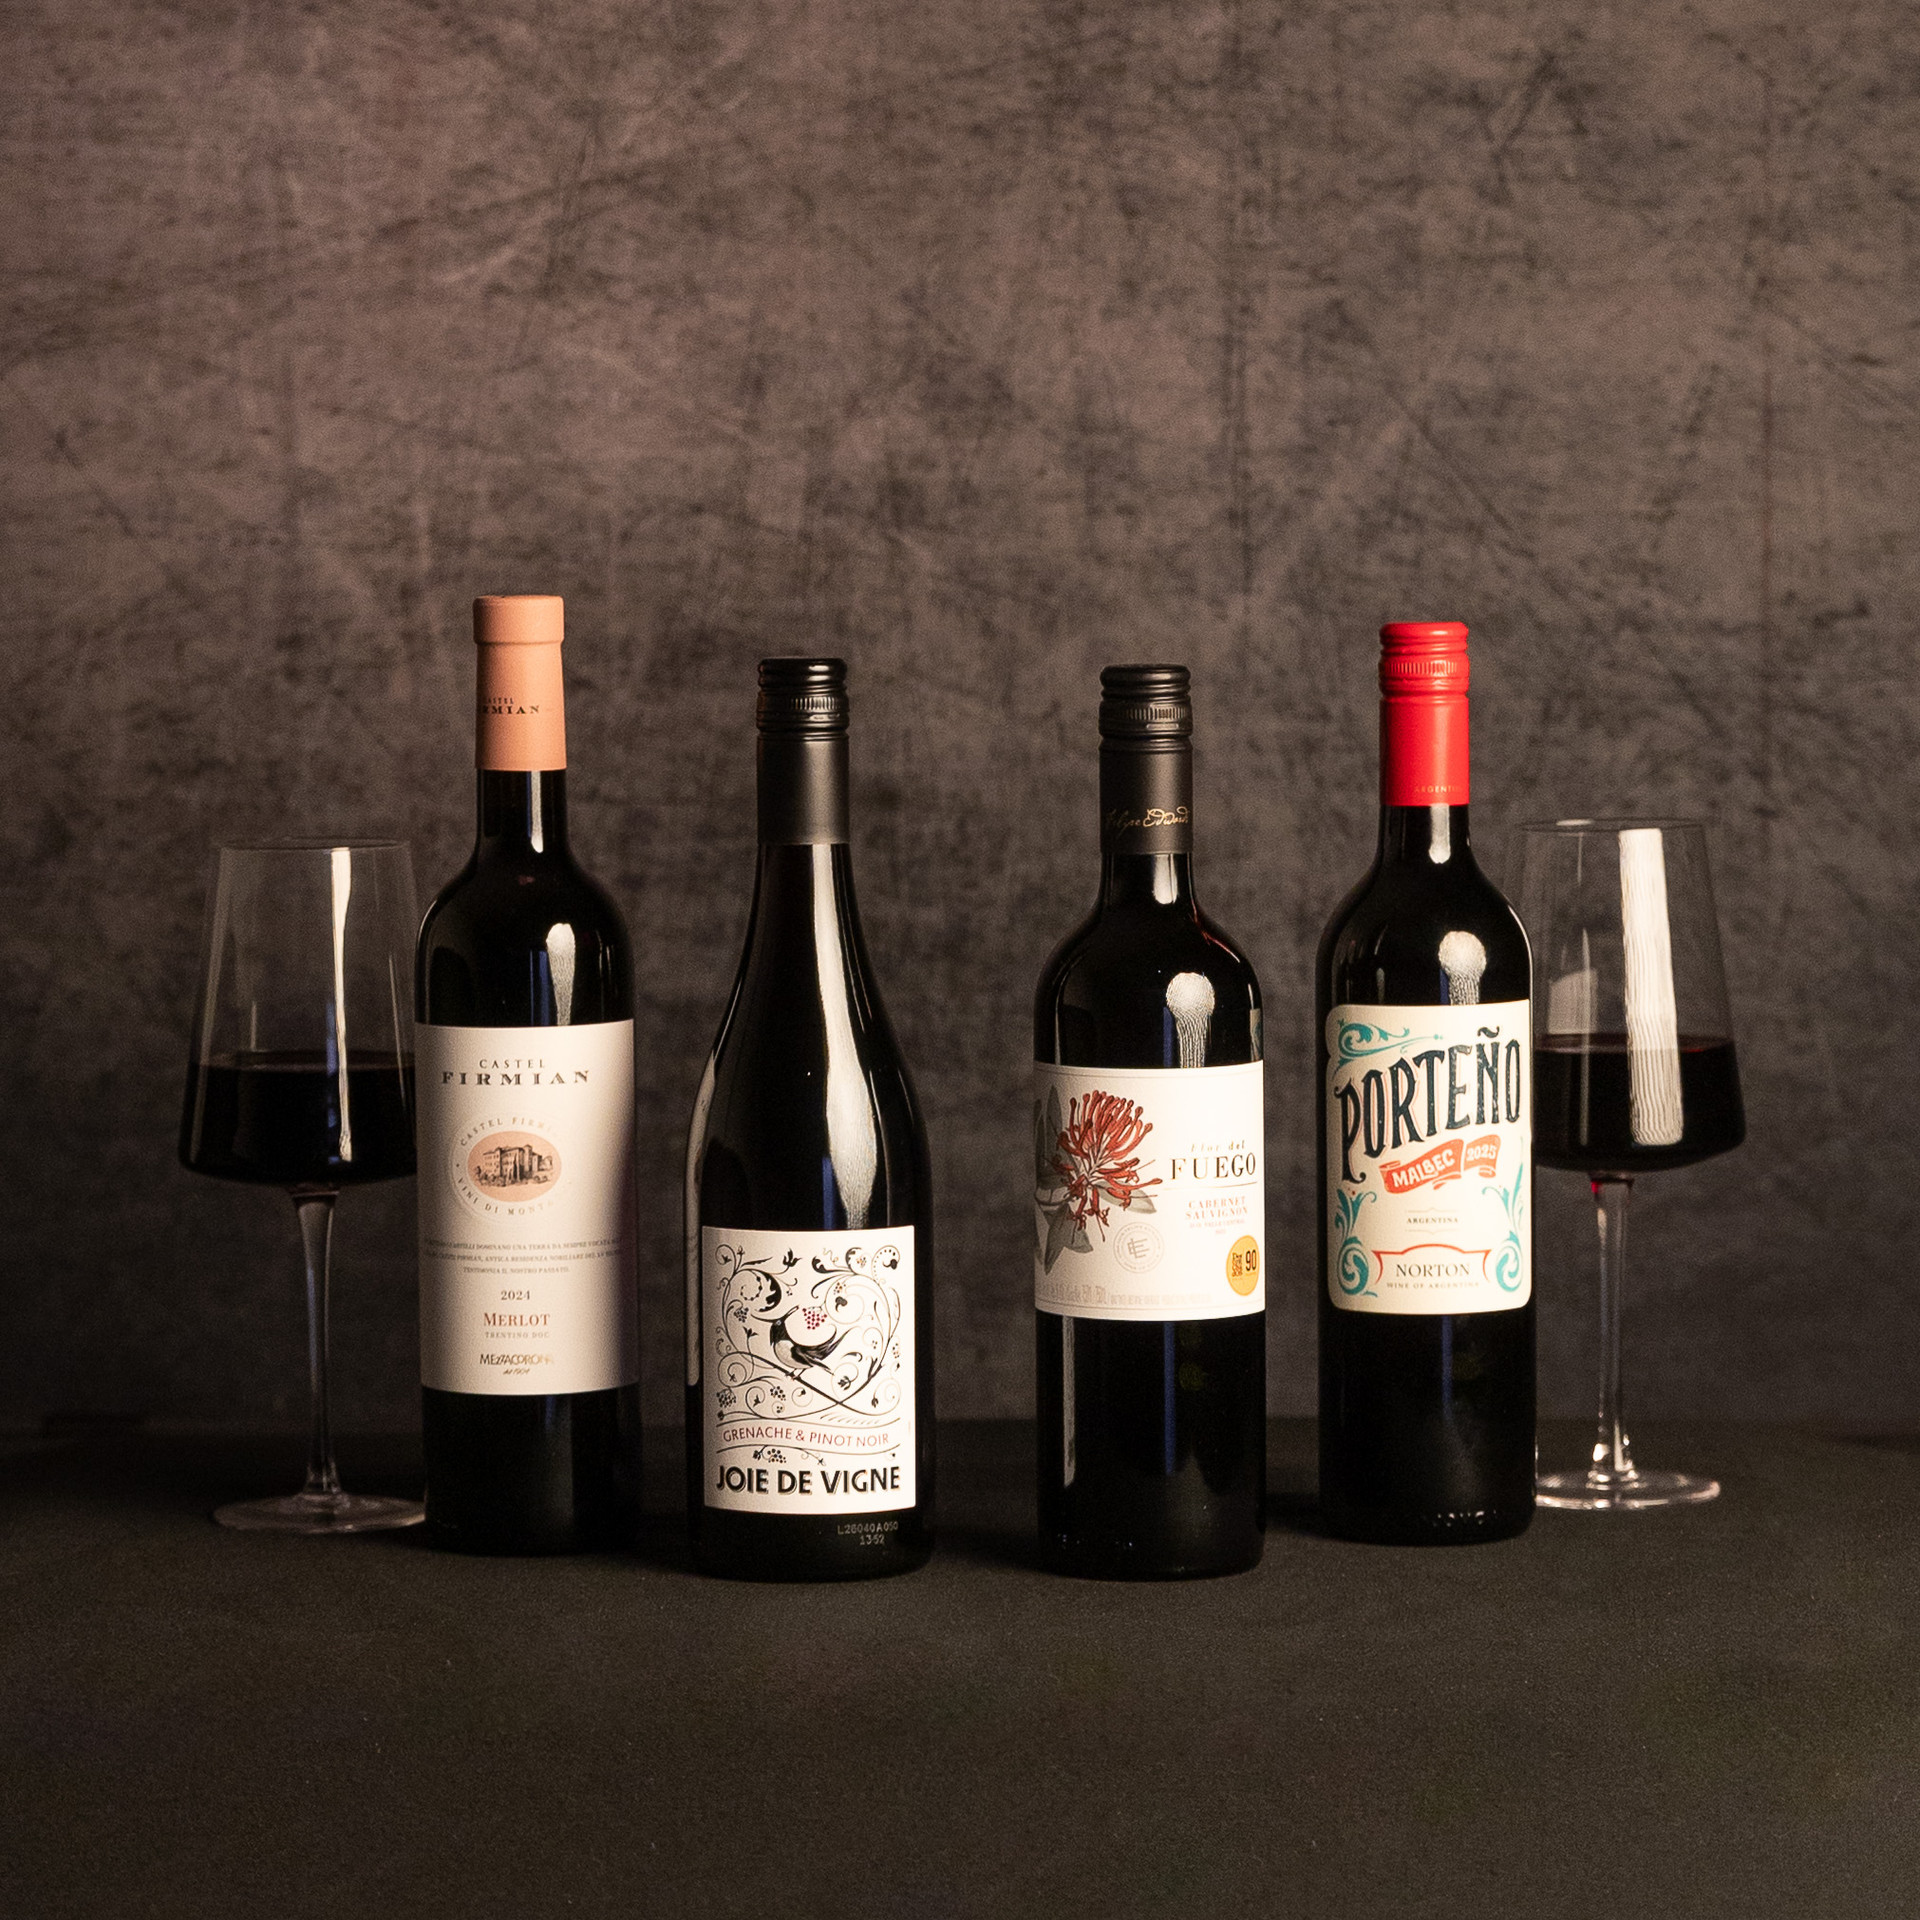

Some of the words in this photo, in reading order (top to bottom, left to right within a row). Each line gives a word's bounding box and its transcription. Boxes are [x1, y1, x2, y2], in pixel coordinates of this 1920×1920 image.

[479, 1058, 546, 1069] CASTEL
[442, 1070, 590, 1086] FIRMIAN
[1334, 1026, 1522, 1184] PORTEÑO
[460, 1117, 504, 1146] CASTEL
[1169, 1152, 1256, 1180] FUEGO
[1392, 1149, 1456, 1187] MALBEC
[1466, 1144, 1497, 1161] 2025
[485, 1203, 498, 1214] DI
[1188, 1195, 1246, 1209] CABERNET
[1185, 1206, 1249, 1220] SAUVIGNON
[1406, 1217, 1459, 1225] ARGENTINA
[1245, 1249, 1257, 1271] 90
[1396, 1263, 1470, 1277] NORTON
[500, 1290, 530, 1301] 2024
[483, 1312, 550, 1326] MERLOT
[485, 1331, 529, 1339] TRENTINO
[722, 1426, 792, 1443] GRENACHE
[795, 1430, 805, 1441] &
[809, 1432, 852, 1446] PINOT
[856, 1433, 889, 1447] NOIR
[716, 1466, 769, 1494] JOIE
[777, 1470, 812, 1495] DE
[821, 1466, 900, 1494] VIGNE
